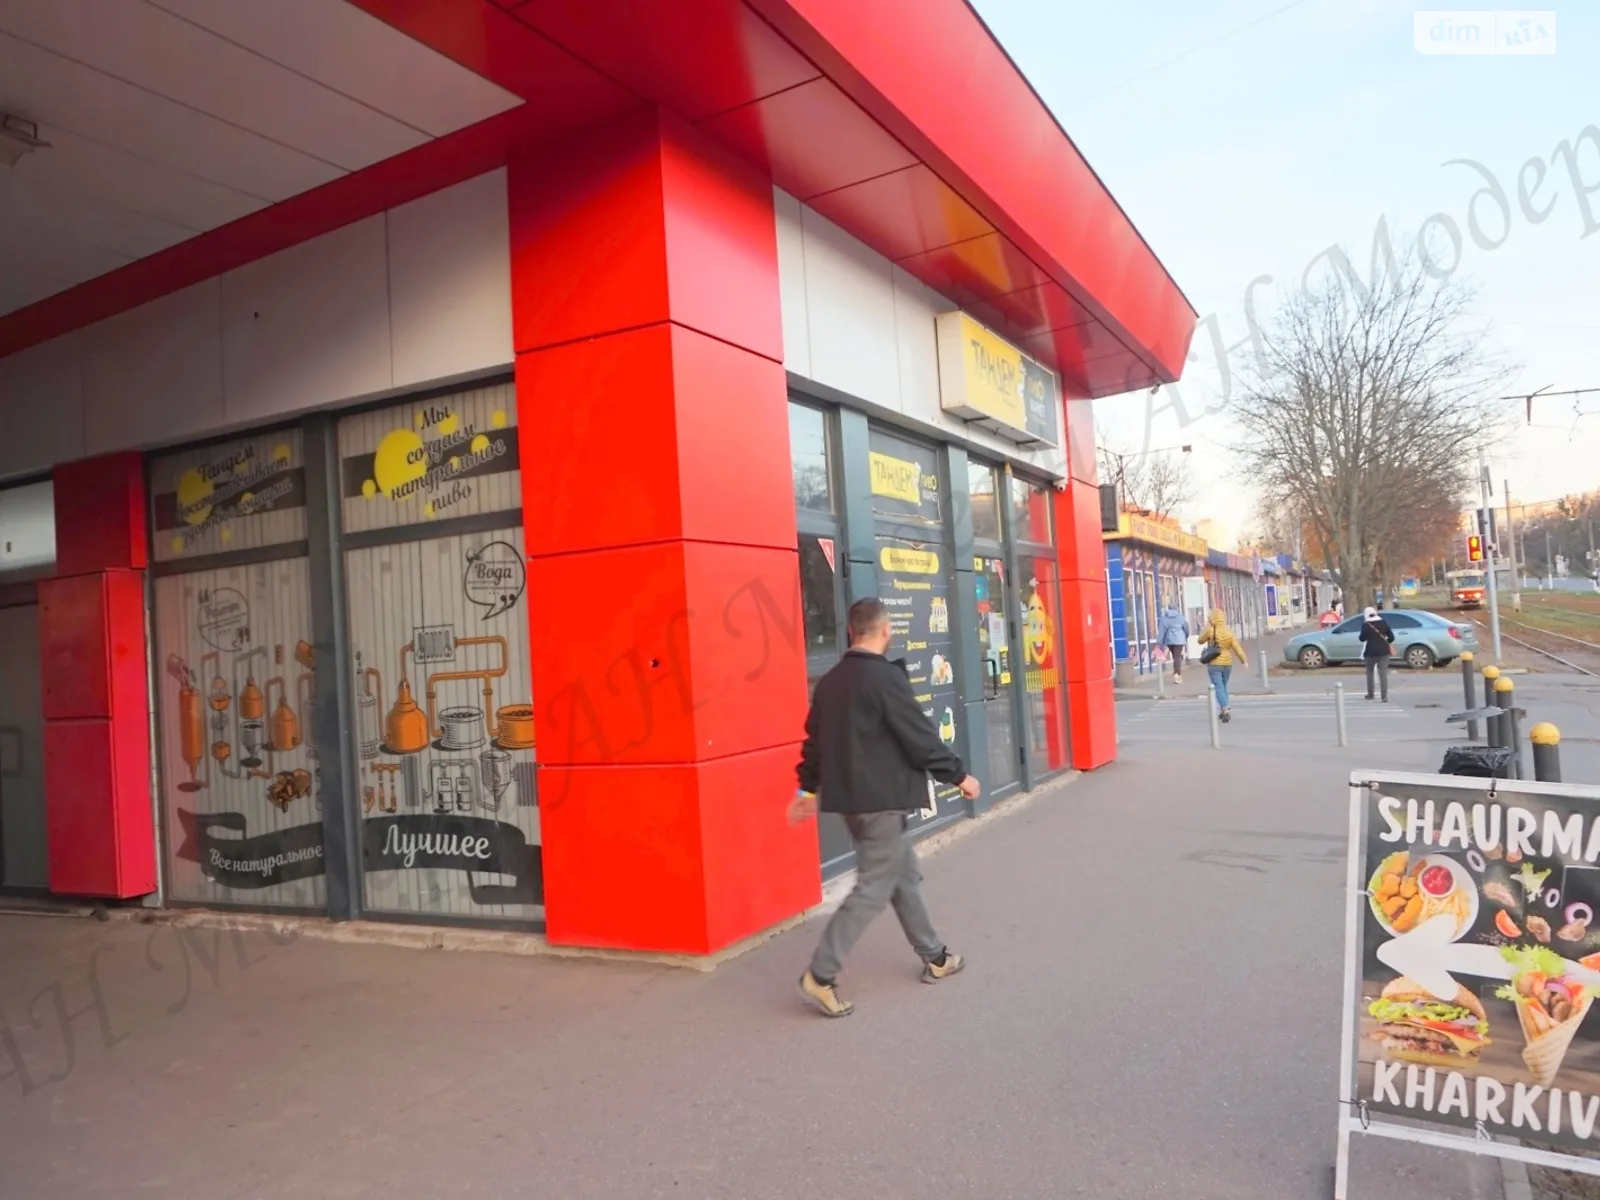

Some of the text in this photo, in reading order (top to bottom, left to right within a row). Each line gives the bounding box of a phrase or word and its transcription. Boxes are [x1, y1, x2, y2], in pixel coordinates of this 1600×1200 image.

[419, 405, 451, 430] Мы
[406, 423, 477, 465] создаем
[197, 445, 255, 483] Тандем
[391, 438, 506, 501] натуральное
[431, 483, 472, 512] пиво
[475, 563, 512, 585] Вода
[209, 843, 323, 876] Все натуральное
[382, 823, 492, 868] Лучшее
[1373, 1058, 1600, 1141] KHARKIV
